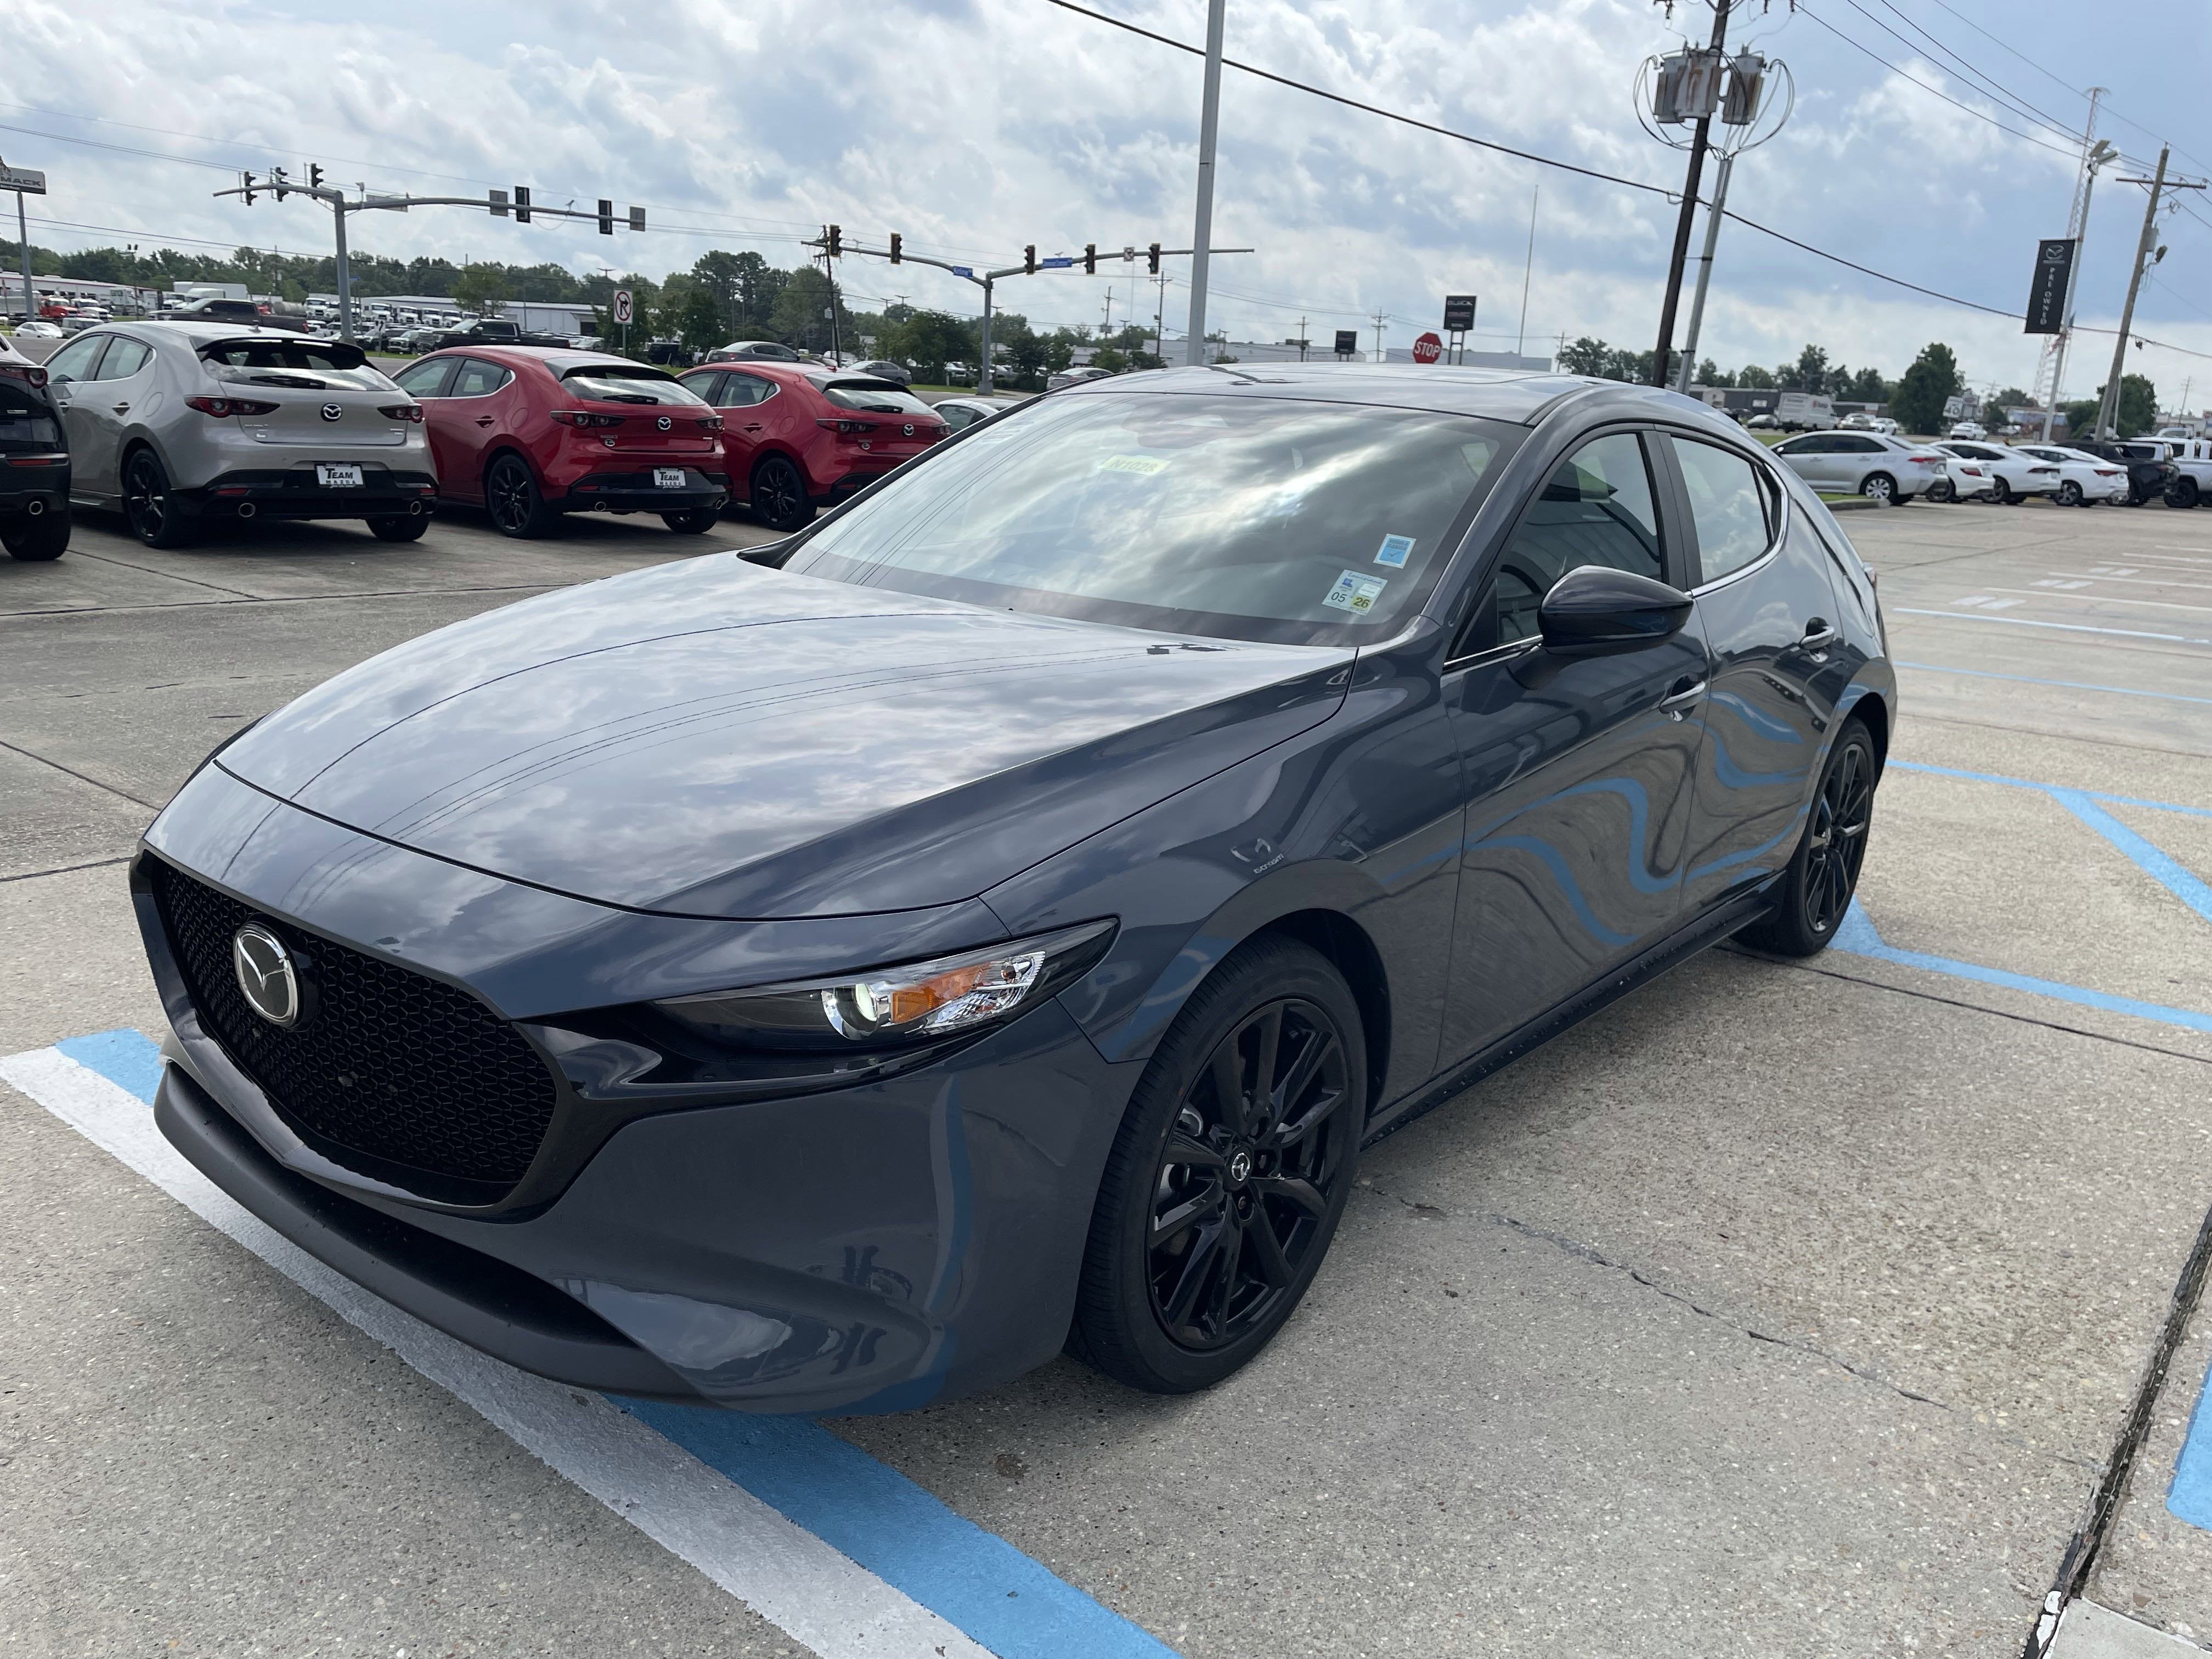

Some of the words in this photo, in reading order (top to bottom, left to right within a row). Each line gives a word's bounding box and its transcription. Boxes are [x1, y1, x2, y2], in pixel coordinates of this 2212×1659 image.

[1, 176, 41, 187] MACK
[1414, 341, 1441, 358] STOP
[1331, 592, 1347, 602] 05
[1353, 597, 1370, 608] 26
